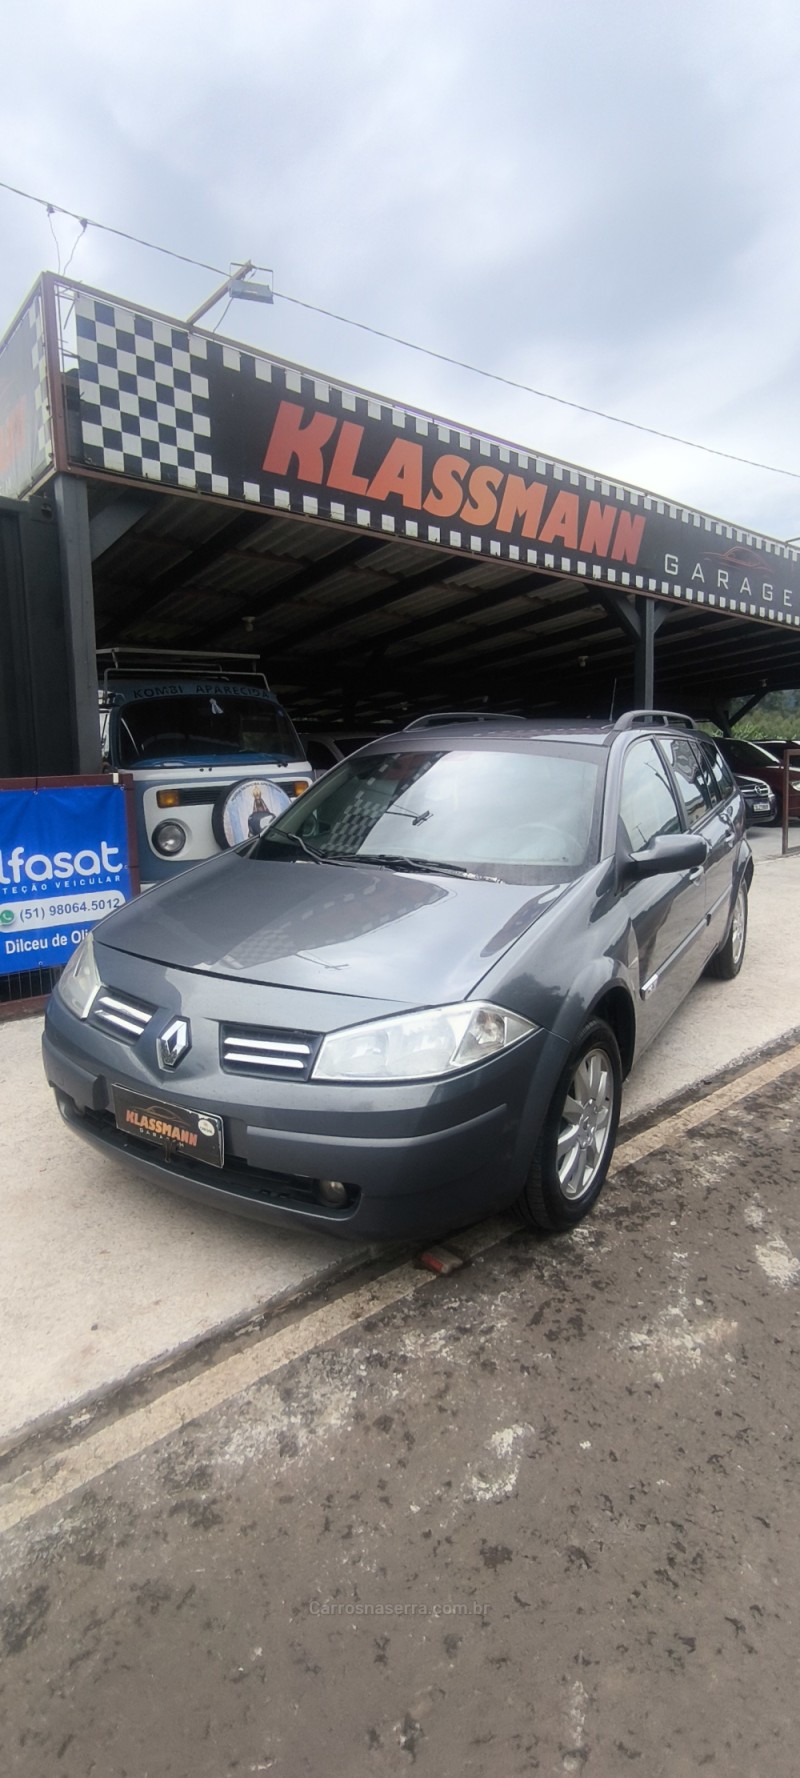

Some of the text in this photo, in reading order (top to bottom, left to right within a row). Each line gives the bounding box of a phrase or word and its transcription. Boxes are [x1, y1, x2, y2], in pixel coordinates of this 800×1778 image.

[262, 400, 793, 607] KLASSMANN GARAGE
[133, 684, 270, 699] KOMBI APARECIDA
[55, 875, 121, 889] VEICULAR
[20, 898, 120, 923] (51) 98064.5012
[5, 937, 48, 955] Dilceu
[52, 933, 68, 947] de
[126, 1109, 198, 1147] KLASSMANN
